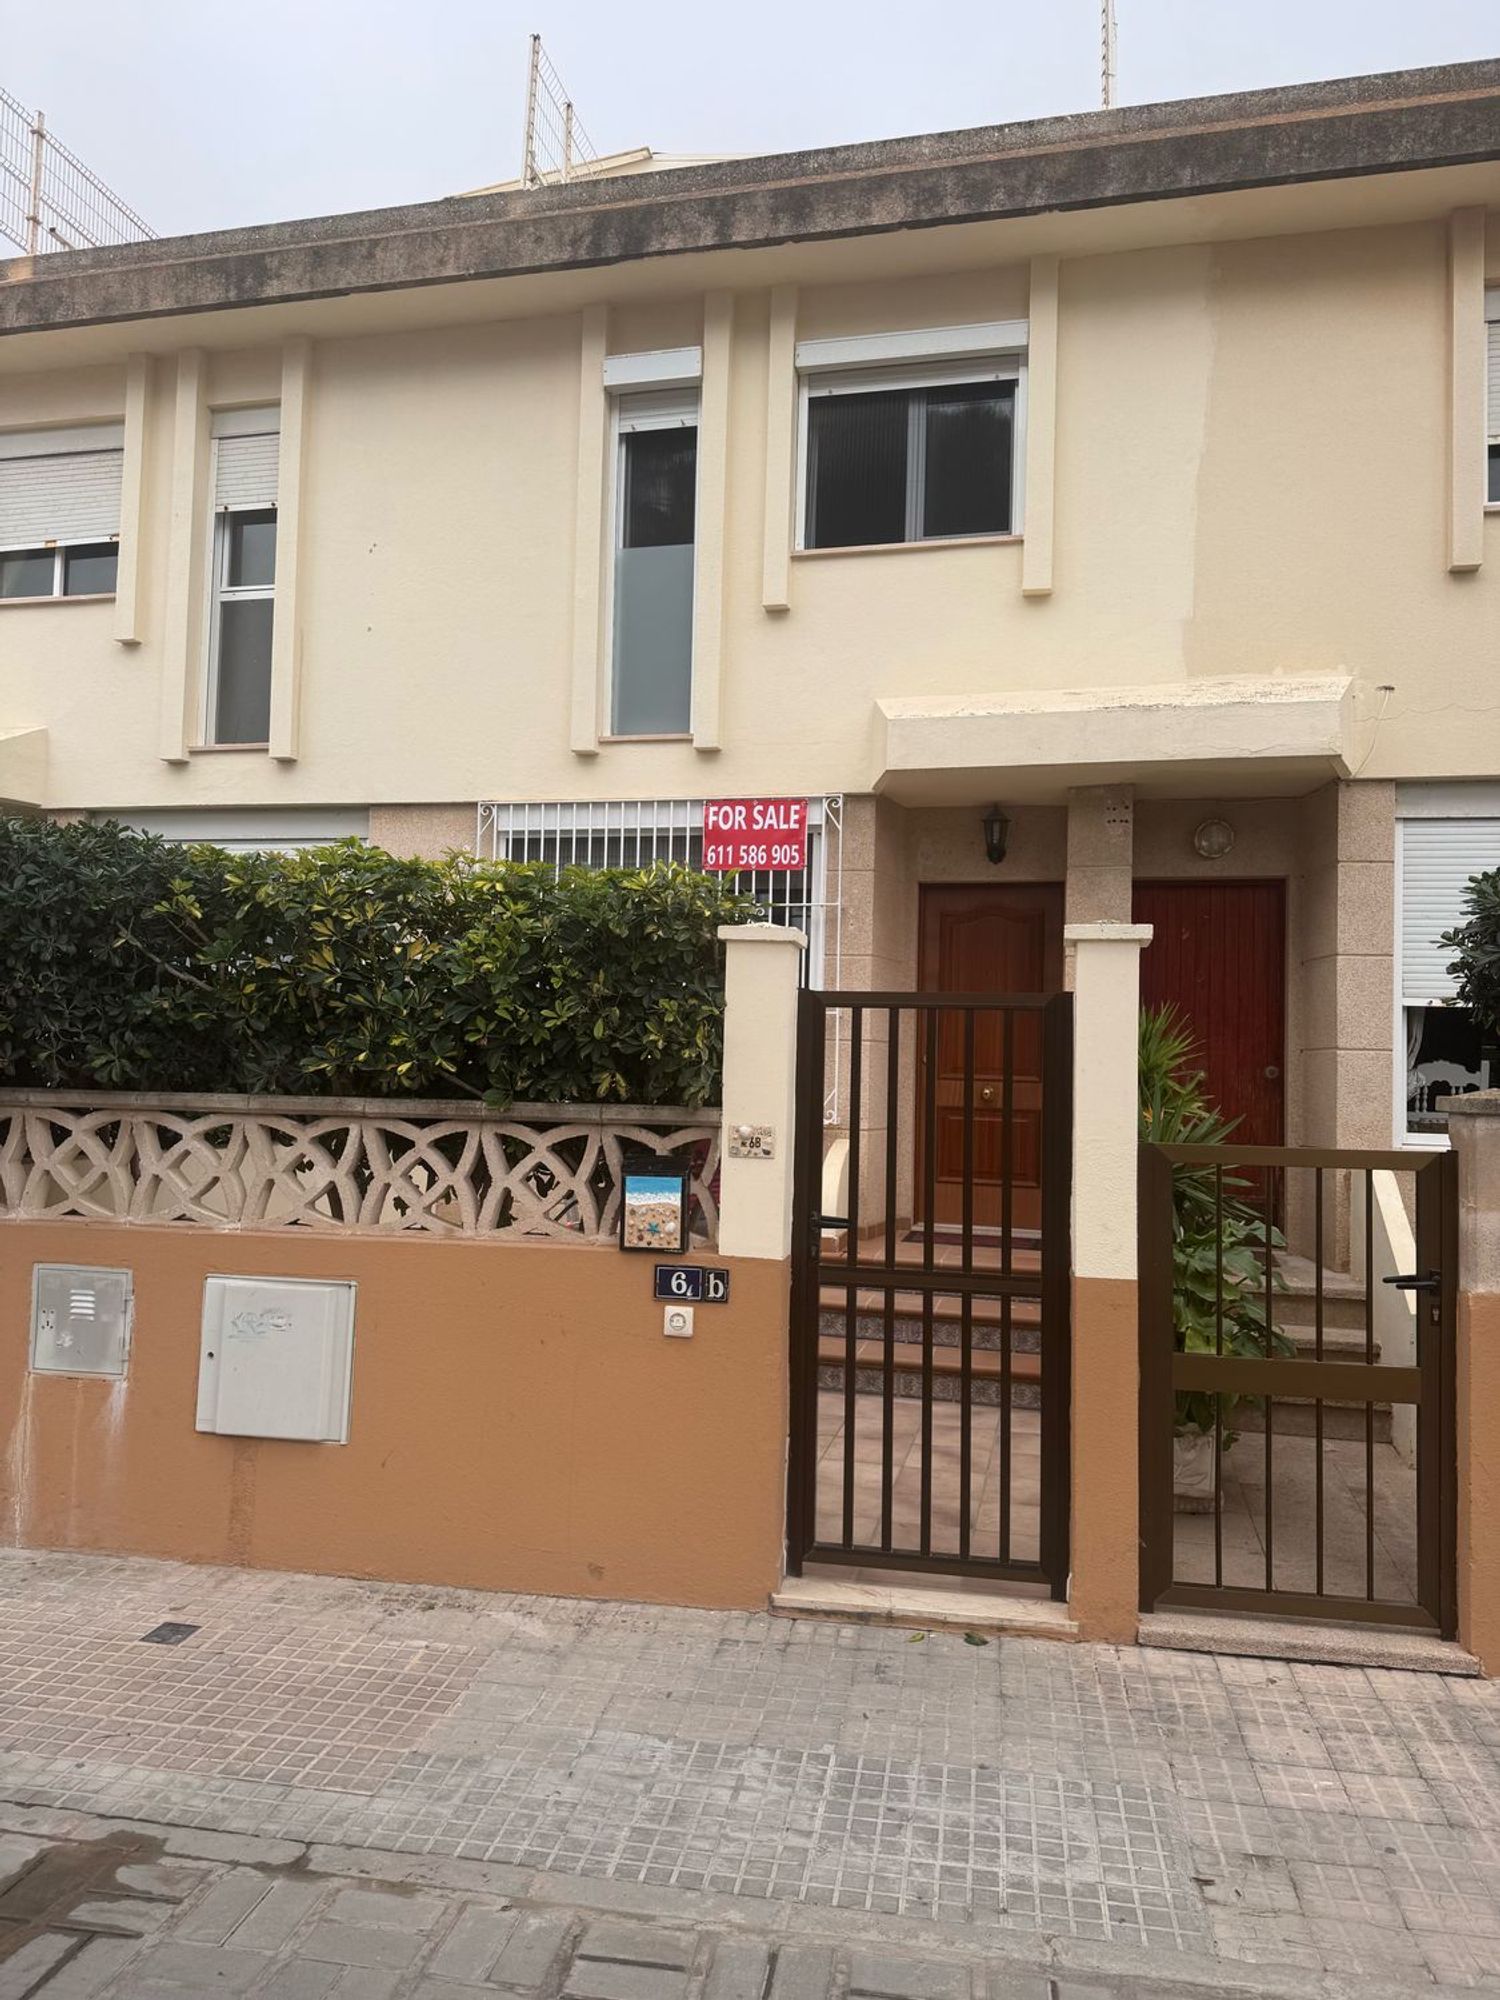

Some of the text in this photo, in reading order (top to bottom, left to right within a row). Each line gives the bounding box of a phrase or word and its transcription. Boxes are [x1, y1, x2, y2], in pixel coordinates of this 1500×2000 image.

[708, 804, 800, 830] FOR SALE
[708, 845, 799, 865] 611 586 905
[708, 1273, 724, 1298] b
